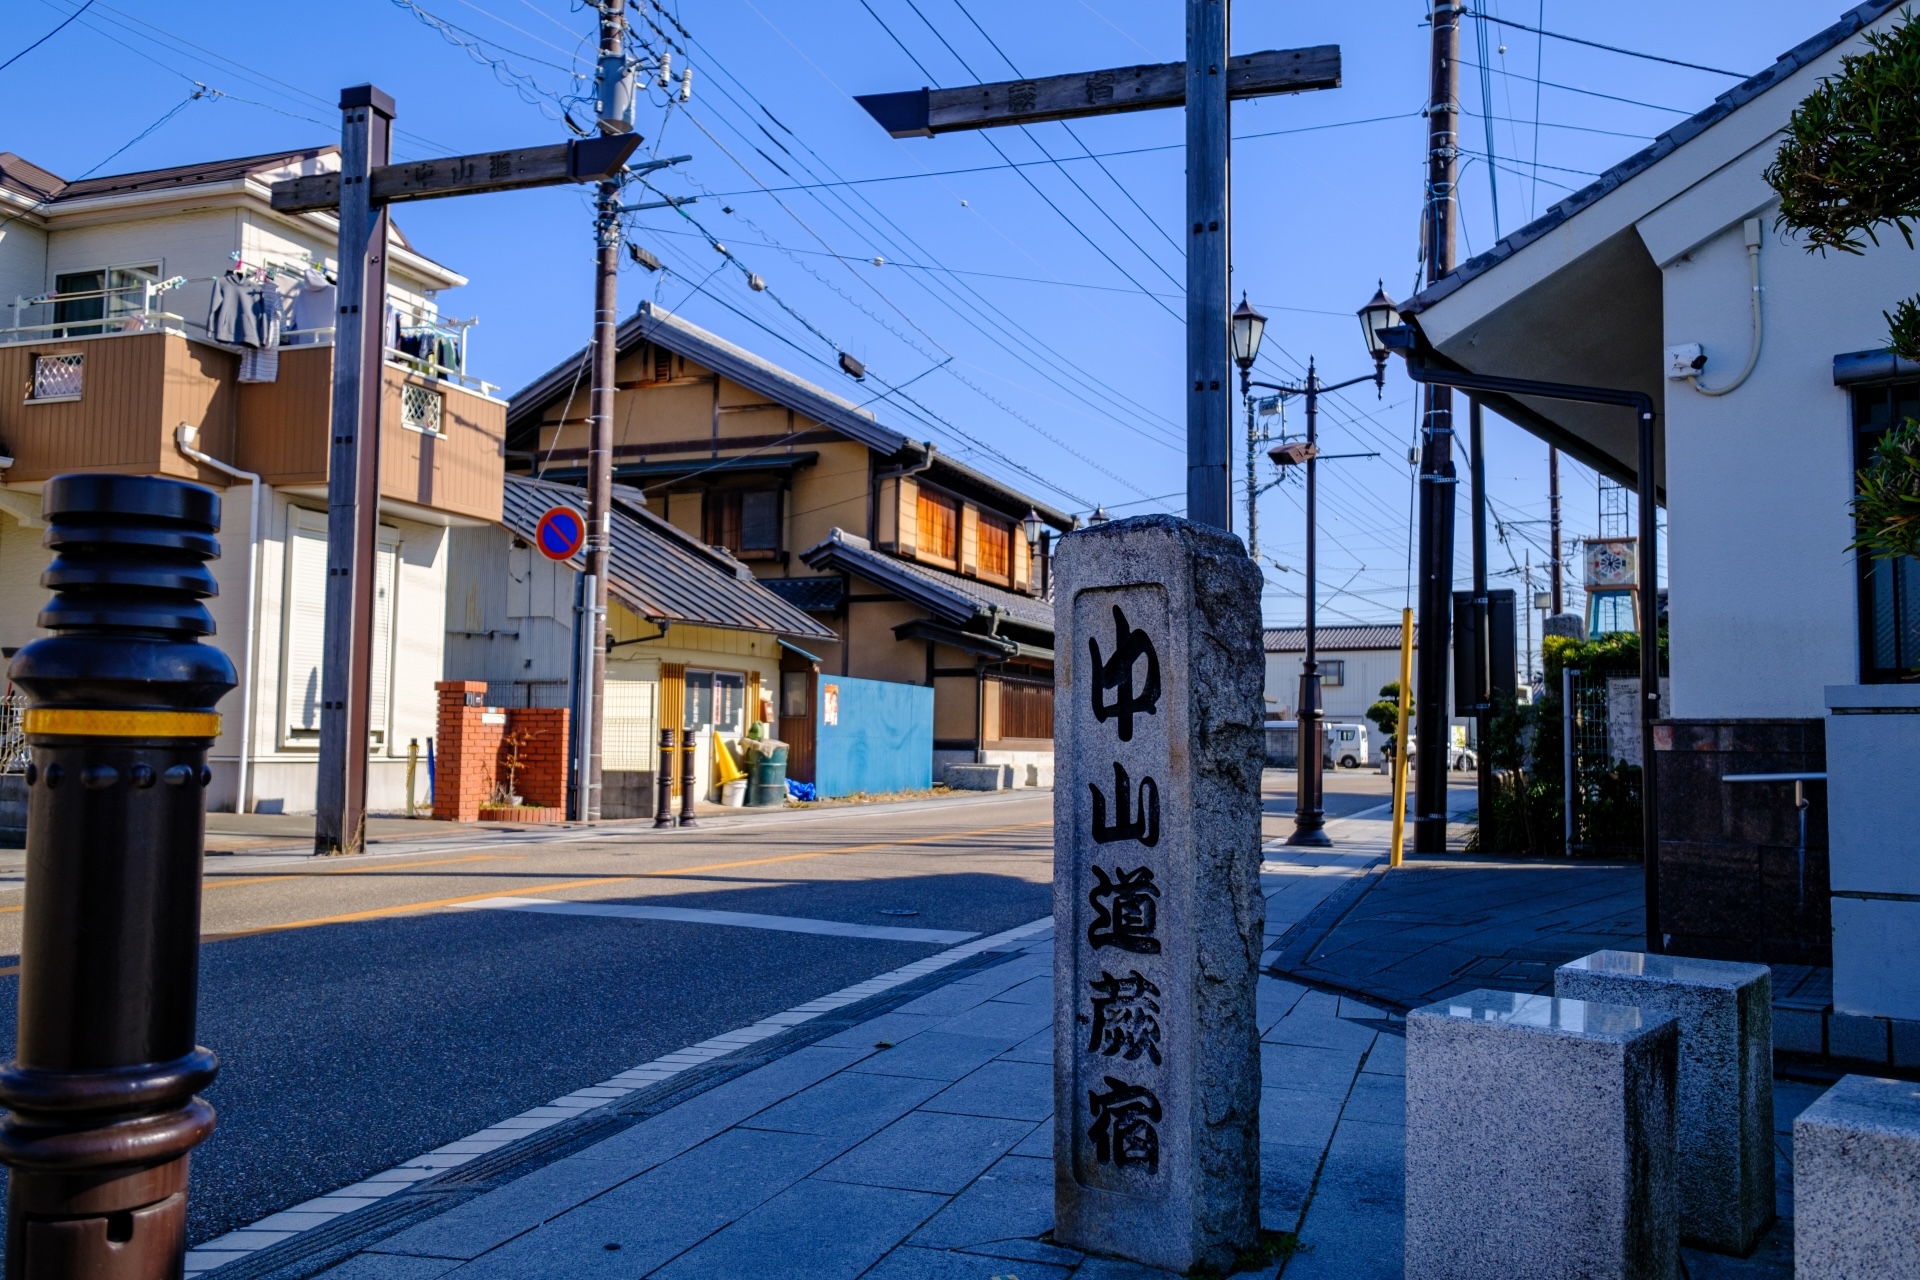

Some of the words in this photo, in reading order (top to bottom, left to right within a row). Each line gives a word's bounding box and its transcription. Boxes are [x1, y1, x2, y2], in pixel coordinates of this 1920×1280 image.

[1008, 72, 1115, 112] 蕨宿
[415, 153, 511, 187] 中山道
[1088, 604, 1162, 1175] 中山道蕨宿
